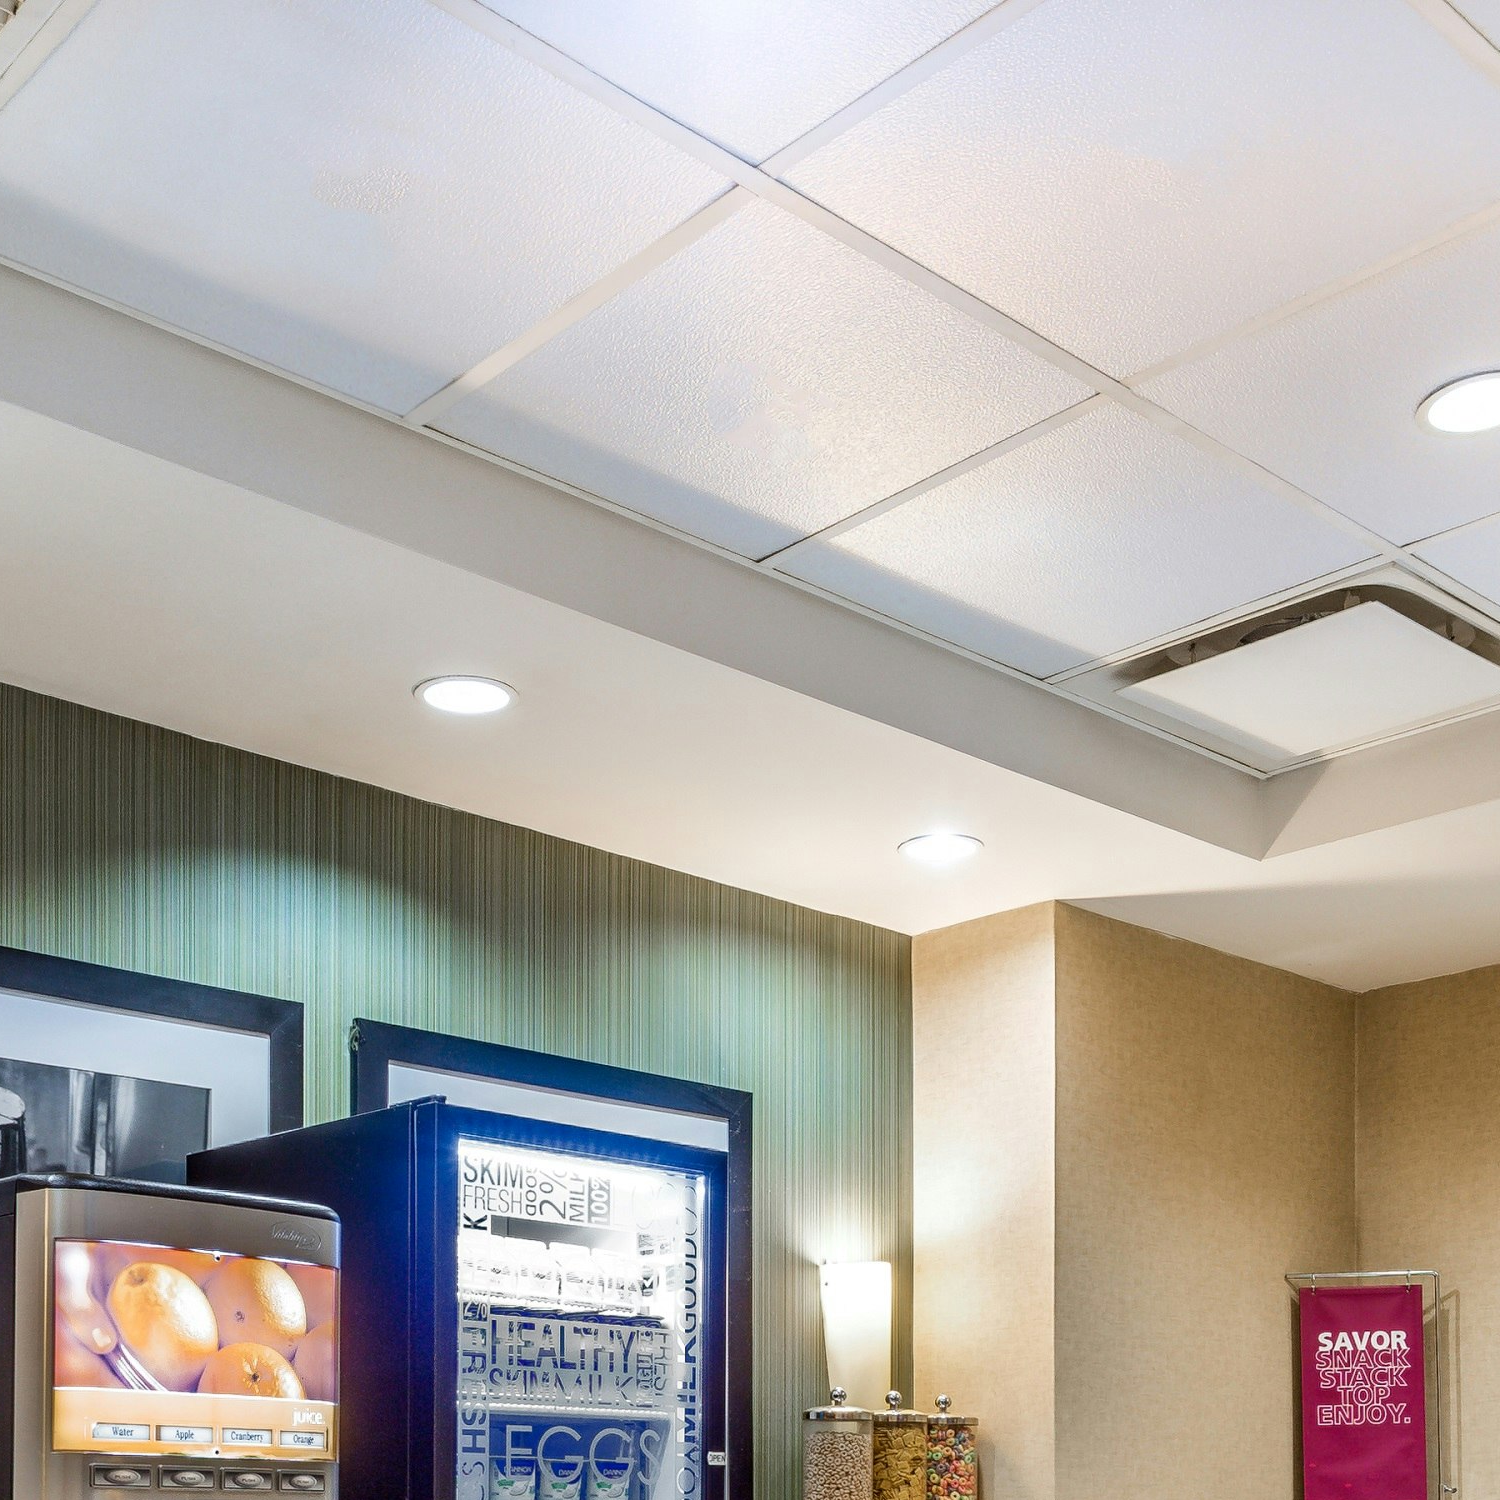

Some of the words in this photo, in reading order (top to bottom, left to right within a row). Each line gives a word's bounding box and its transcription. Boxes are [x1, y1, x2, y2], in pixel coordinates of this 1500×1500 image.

[463, 1155, 524, 1190] SKIM
[463, 1184, 523, 1216] FRESH
[589, 1176, 610, 1225] 100%
[675, 1238, 698, 1335] GOOD
[490, 1318, 637, 1375] HEALTHY
[1317, 1331, 1408, 1351] SAVOR
[1315, 1347, 1412, 1370] SNACK
[675, 1335, 698, 1443] MILK
[1320, 1366, 1408, 1389] STACK
[461, 1326, 488, 1454] FRESH
[555, 1372, 635, 1407] MILK
[1337, 1386, 1391, 1407] TOP
[291, 1408, 326, 1426] juice.
[1317, 1402, 1411, 1425] ENJOY.
[111, 1427, 135, 1437] Water
[174, 1430, 195, 1440] Apple
[230, 1431, 264, 1443] Cranberry
[292, 1434, 315, 1446] Orange
[505, 1424, 661, 1488] EGGS
